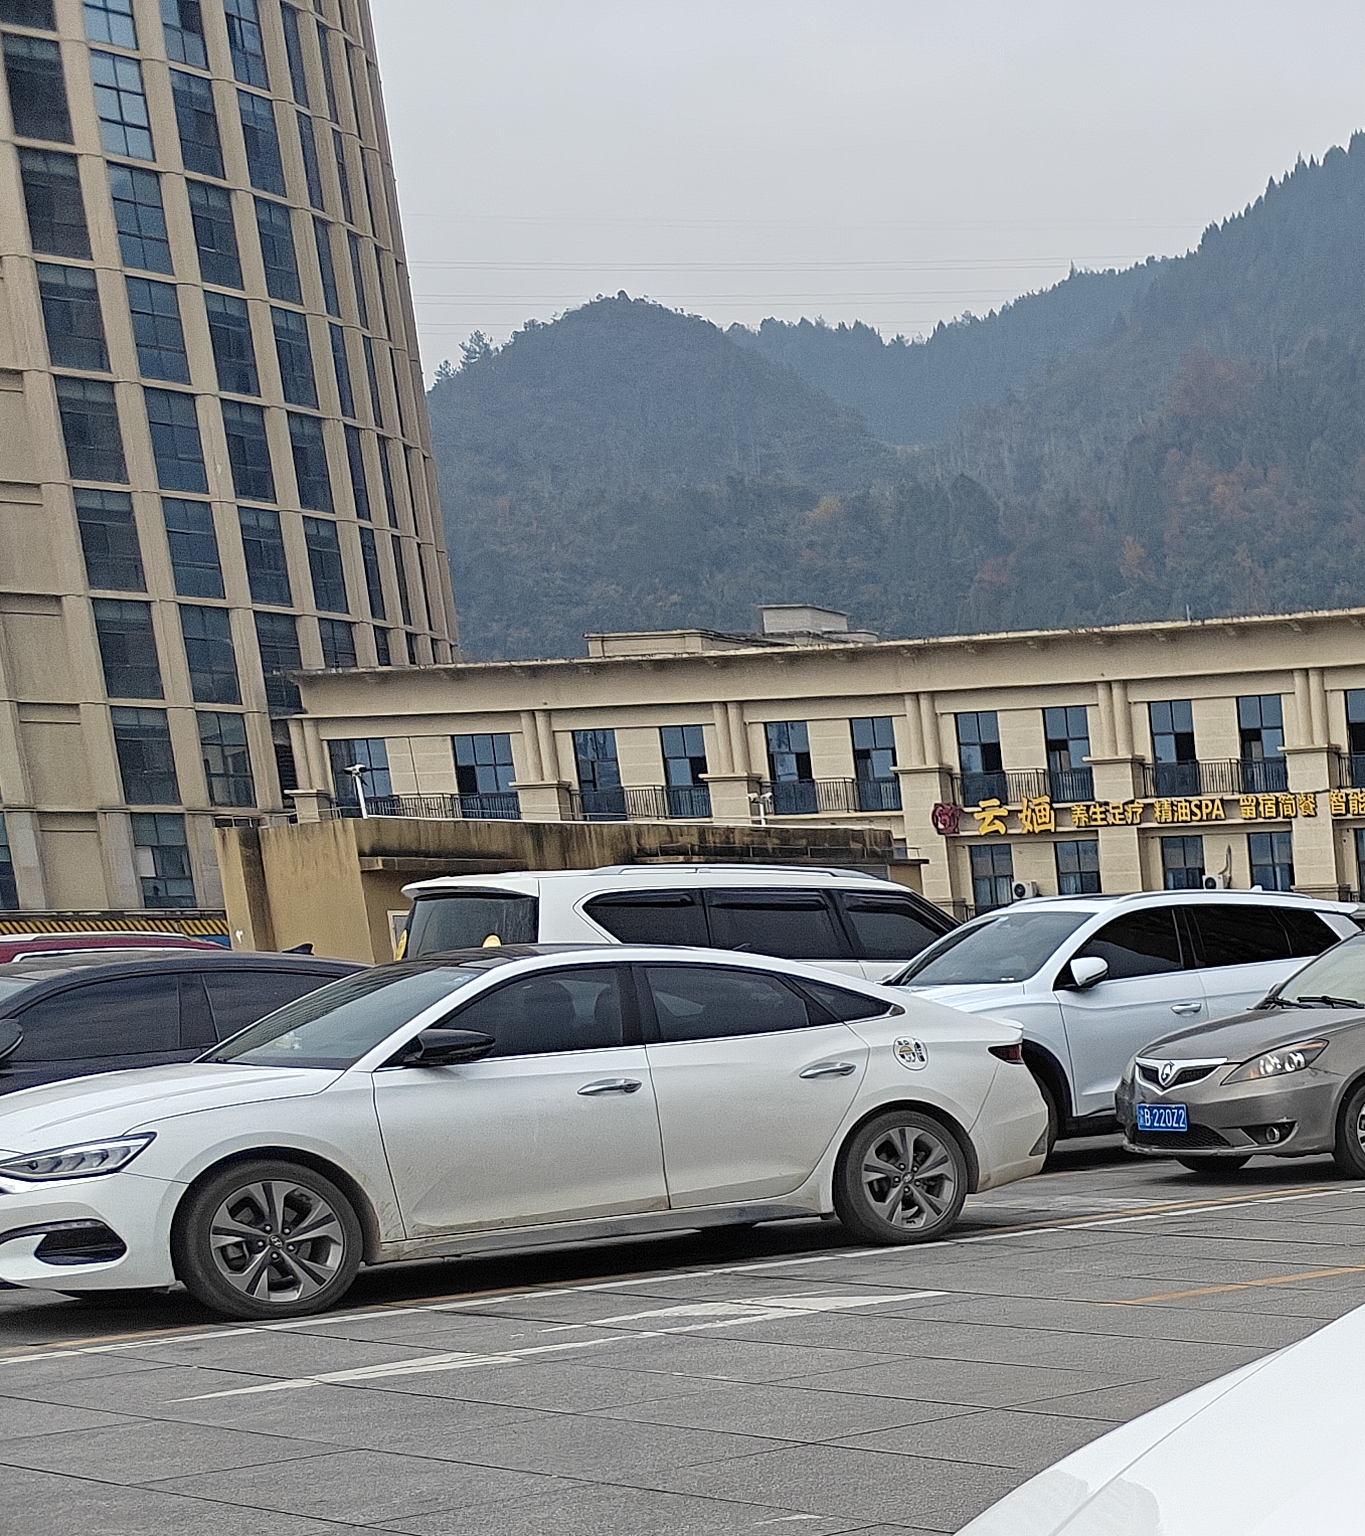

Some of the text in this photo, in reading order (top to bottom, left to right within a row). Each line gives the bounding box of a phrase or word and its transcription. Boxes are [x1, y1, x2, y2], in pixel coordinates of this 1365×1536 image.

[1071, 802, 1144, 828] 养生足疗
[1153, 797, 1226, 824] 精油SPA
[1239, 793, 1317, 820] 留宿简餐
